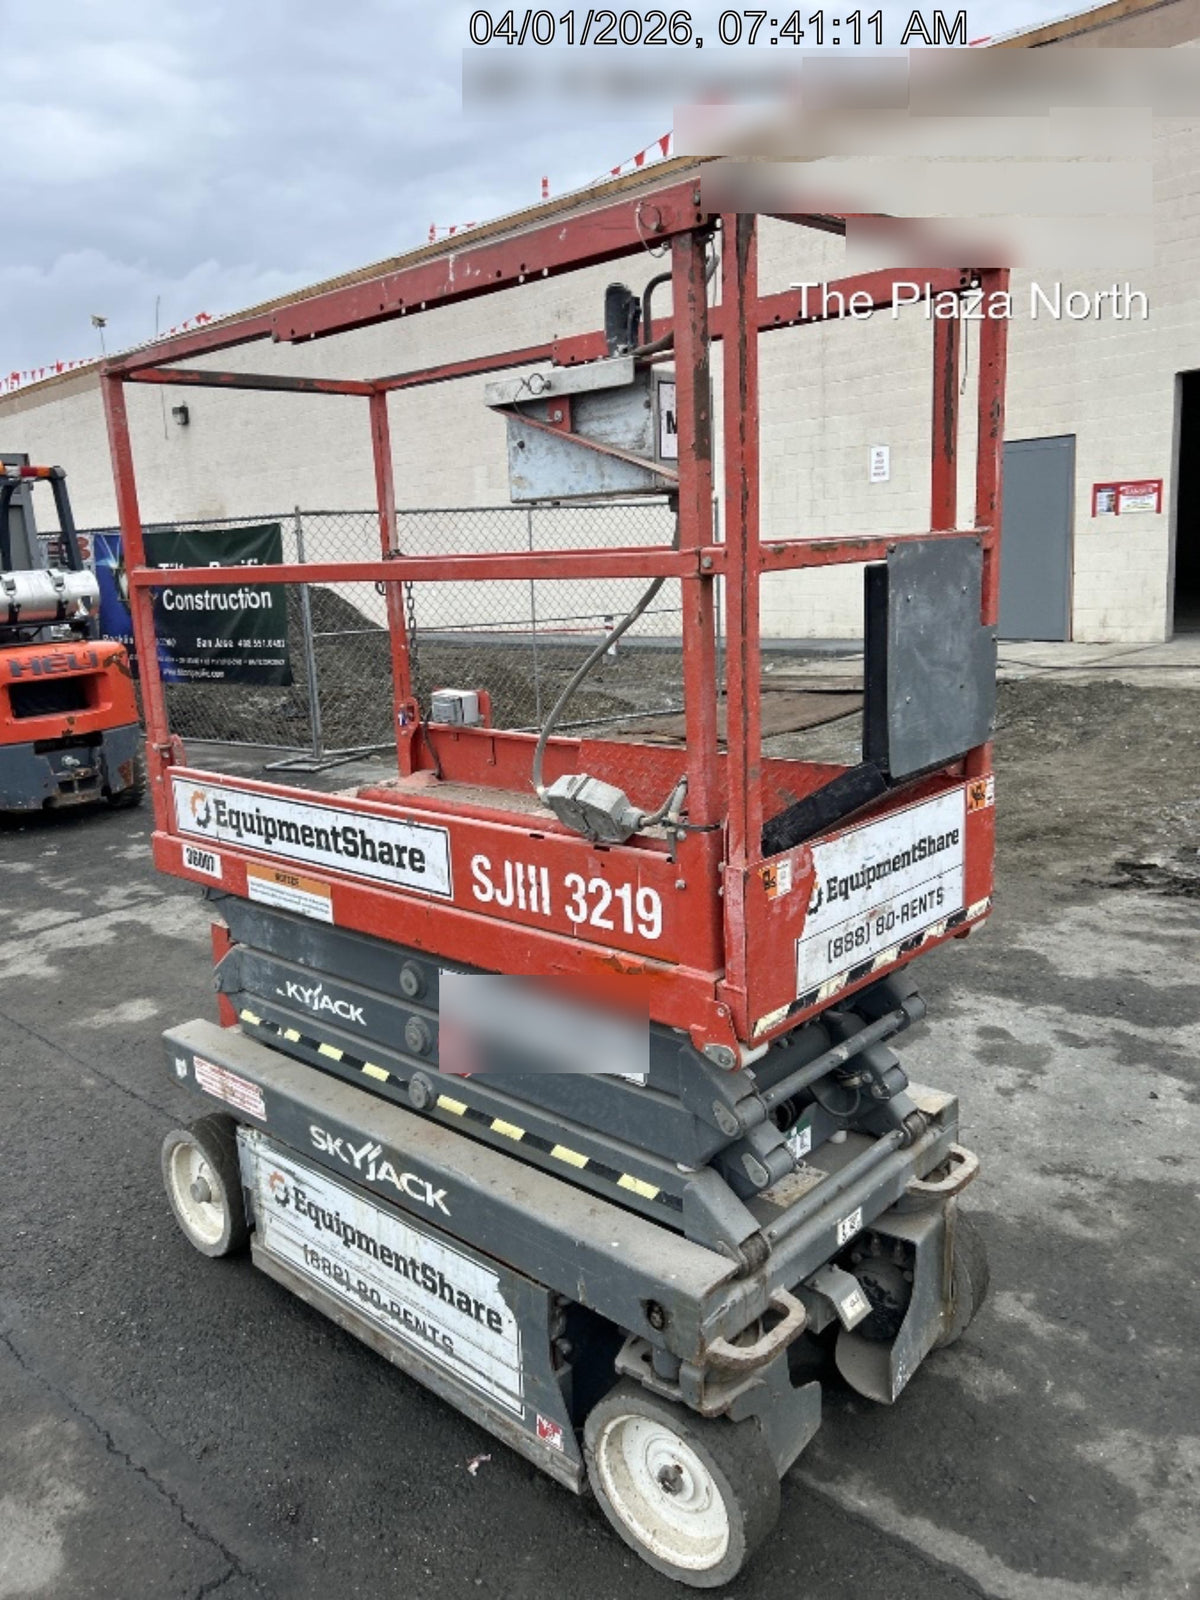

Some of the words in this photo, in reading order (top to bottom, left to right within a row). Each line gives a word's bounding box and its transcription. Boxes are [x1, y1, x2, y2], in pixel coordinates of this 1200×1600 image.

[162, 587, 273, 611] Construction
[7, 649, 99, 678] HELI
[213, 799, 427, 874] EquipmentShare
[826, 828, 960, 904] EquipmentShare
[563, 872, 663, 940] 3219
[827, 922, 871, 964] (888)
[875, 886, 945, 936] 80-RENTS
[309, 1124, 452, 1217] SKYJACK
[291, 1187, 504, 1336] EquipmentShare
